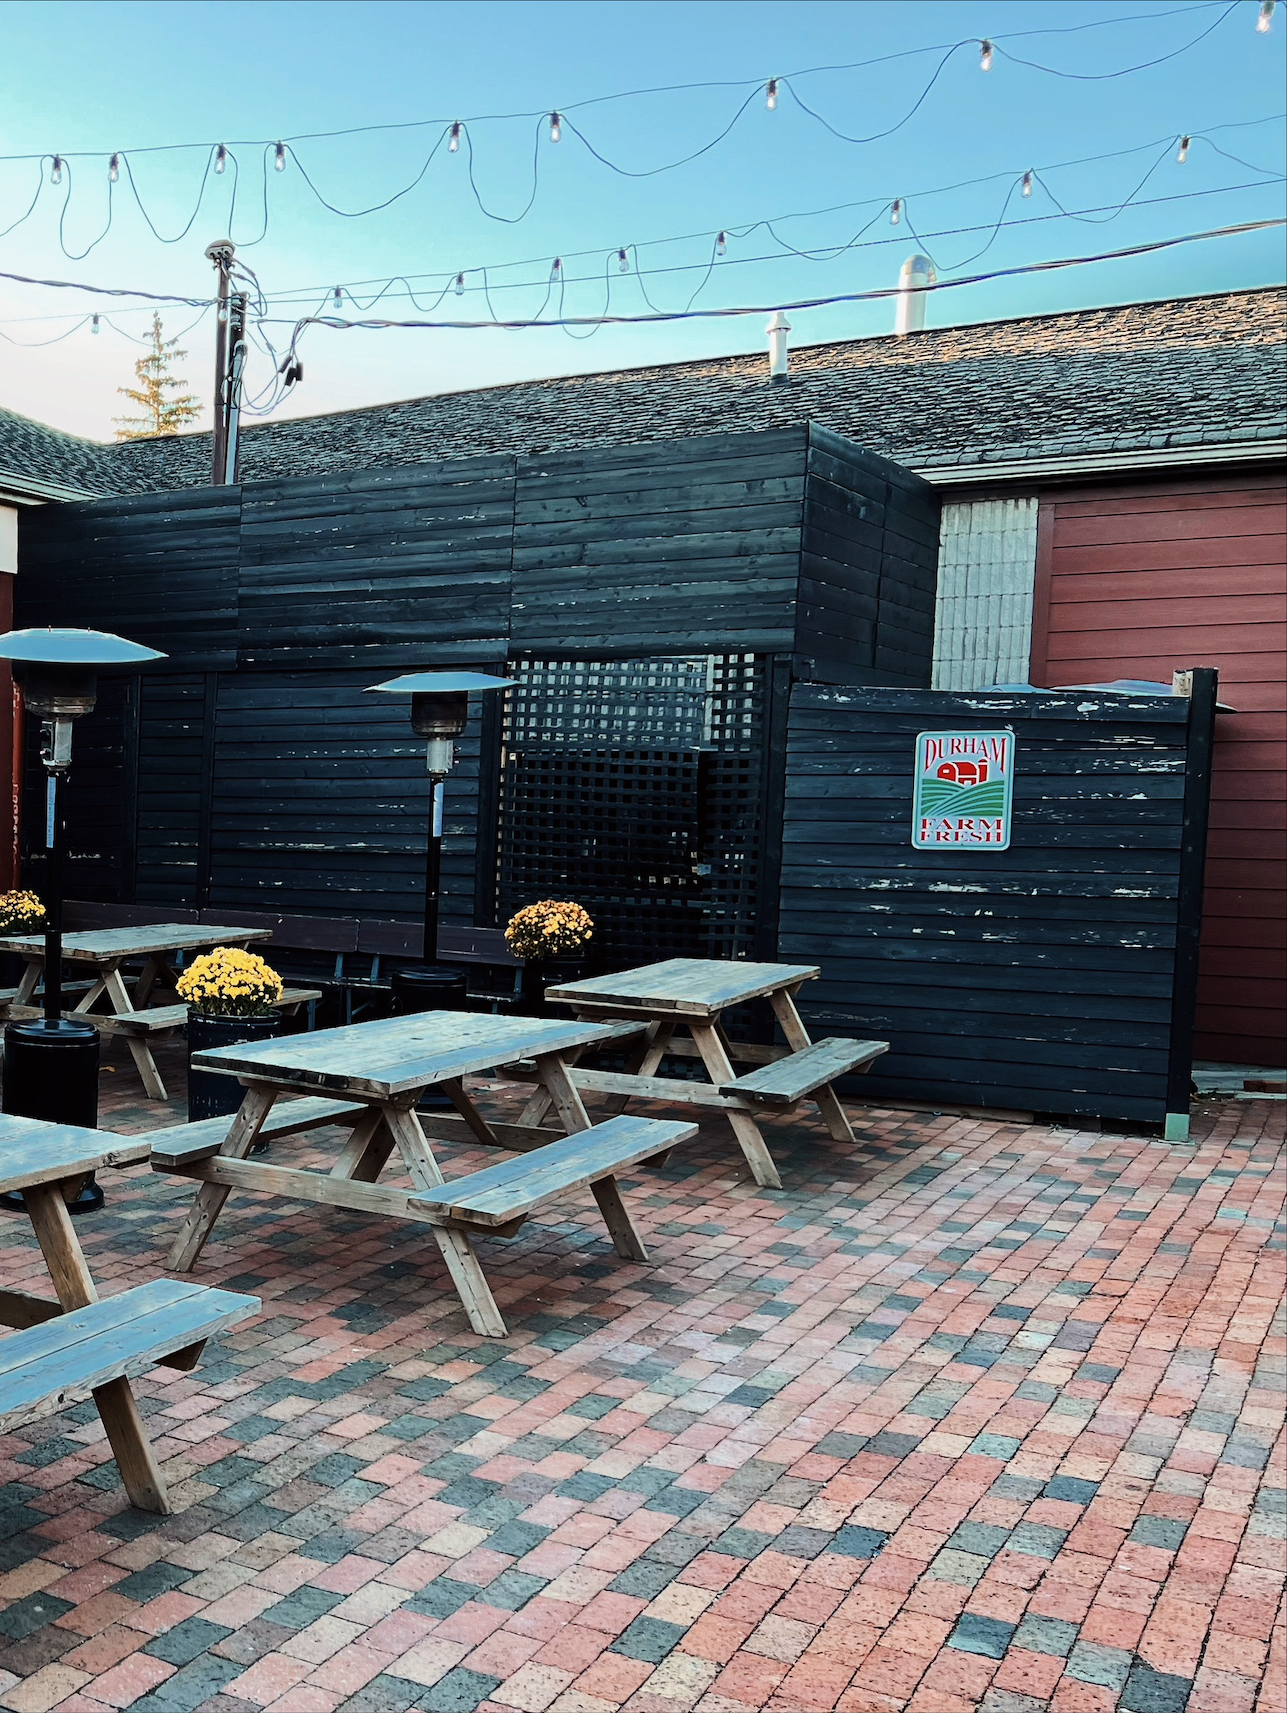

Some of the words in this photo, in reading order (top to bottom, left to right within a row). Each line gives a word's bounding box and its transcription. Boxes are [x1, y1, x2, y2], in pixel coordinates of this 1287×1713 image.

[924, 737, 1007, 776] DURHAM
[920, 818, 1003, 830] FARM
[920, 831, 1002, 842] FRESH
